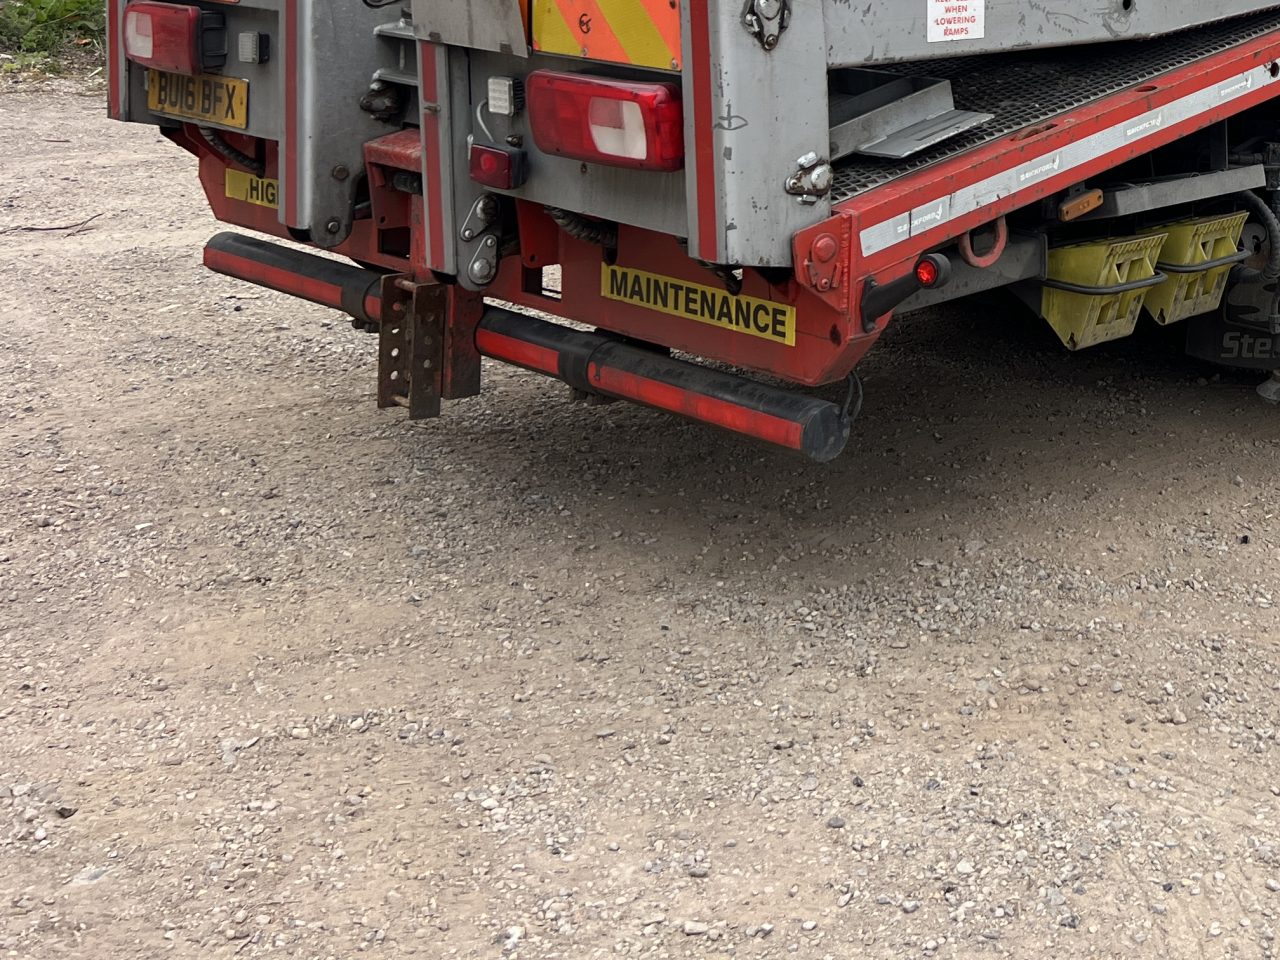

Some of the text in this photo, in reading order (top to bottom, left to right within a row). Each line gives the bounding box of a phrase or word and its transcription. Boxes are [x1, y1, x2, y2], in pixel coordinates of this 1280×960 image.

[944, 5, 967, 13] WHEN
[935, 15, 976, 26] LOWERING
[943, 27, 969, 37] RAMPS
[159, 71, 236, 121] BU16 BFX
[249, 177, 279, 205] HIG
[610, 268, 787, 339] MAINTENANCE
